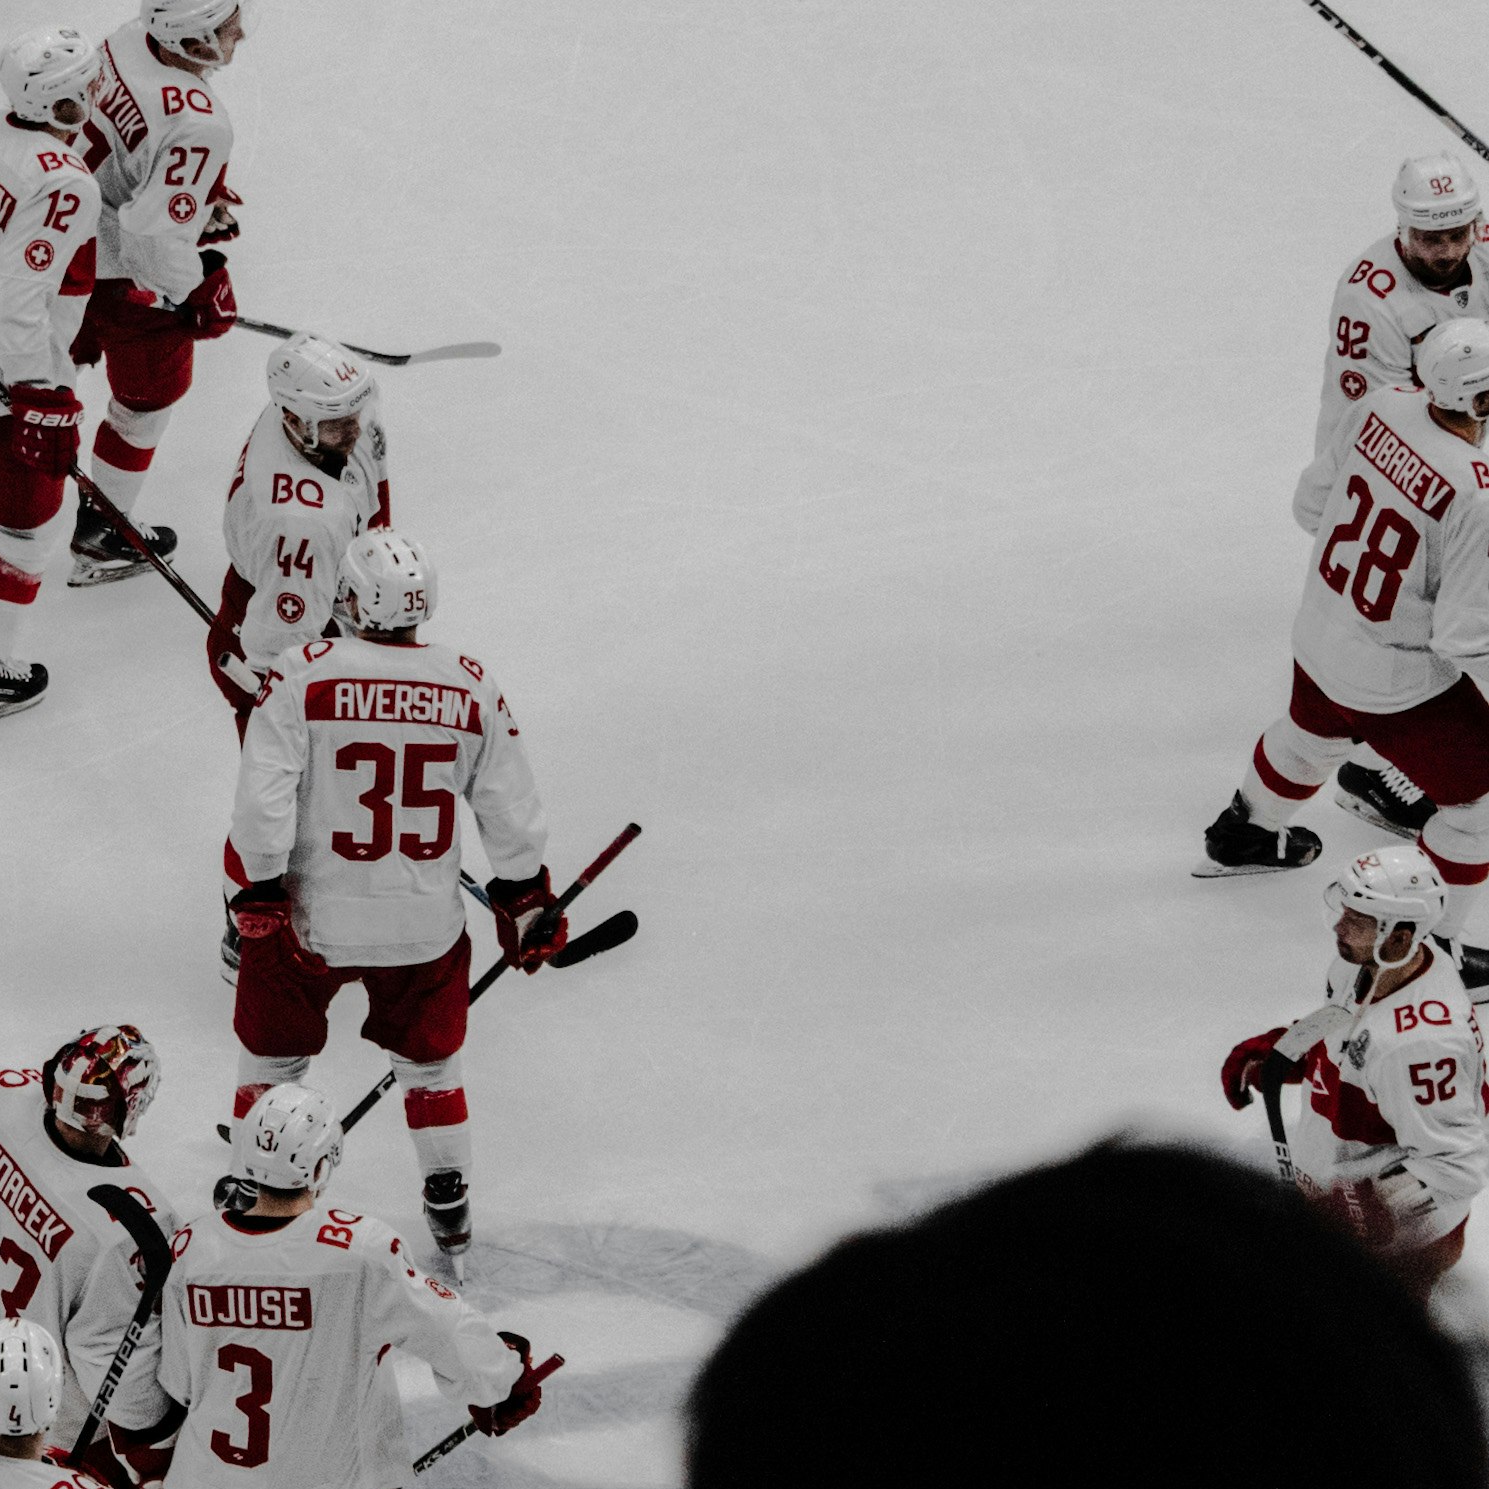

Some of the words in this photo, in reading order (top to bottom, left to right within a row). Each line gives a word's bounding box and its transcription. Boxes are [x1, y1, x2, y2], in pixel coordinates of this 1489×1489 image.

[162, 86, 213, 116] BQ
[165, 147, 210, 186] 27
[1429, 175, 1455, 196] 92
[43, 189, 81, 233] 12
[1348, 259, 1396, 300] BQ
[1336, 315, 1371, 360] 92
[1356, 415, 1450, 512] ZUBAREV
[272, 473, 324, 509] BQ
[276, 535, 314, 579] 44
[1318, 474, 1421, 623] 28
[404, 590, 427, 612] 35
[334, 682, 472, 729] AVERSHIN
[331, 741, 459, 862] 35
[1394, 1000, 1452, 1034] BQ
[1408, 1057, 1457, 1106] 52
[260, 1129, 274, 1153] 3
[192, 1288, 306, 1328] DJUSE
[9, 1404, 22, 1427] 4
[210, 1342, 274, 1469] 3
